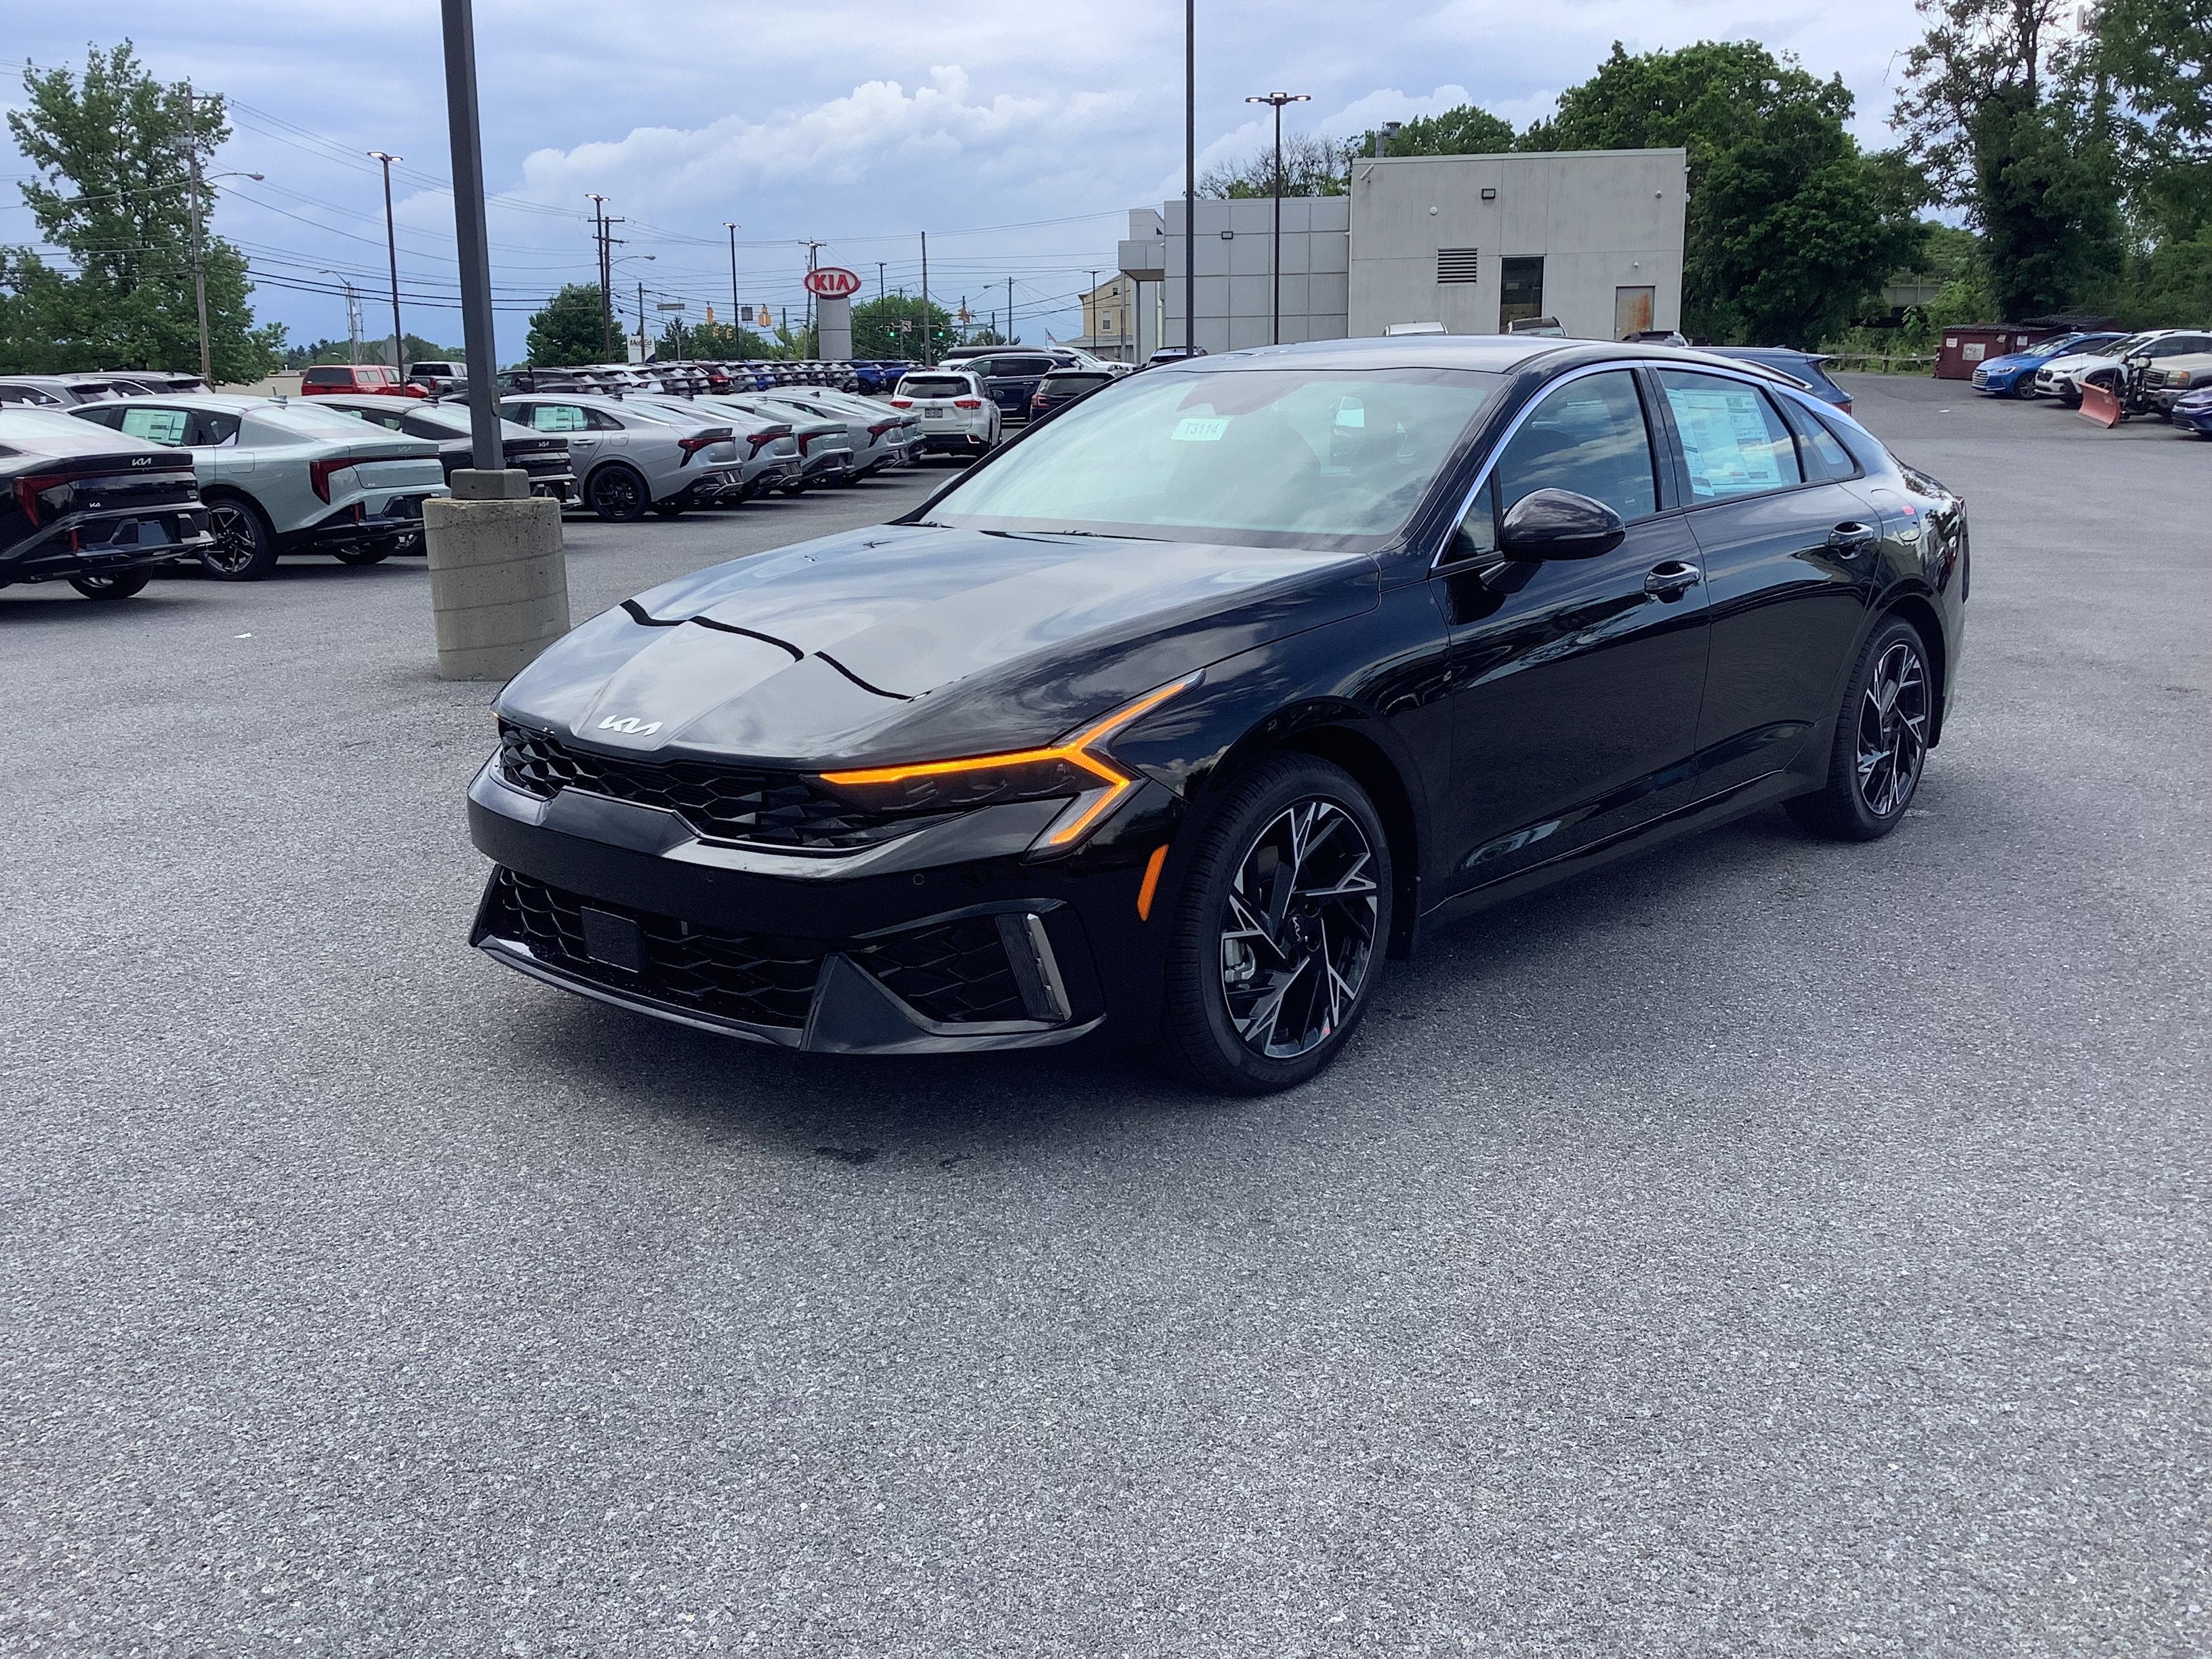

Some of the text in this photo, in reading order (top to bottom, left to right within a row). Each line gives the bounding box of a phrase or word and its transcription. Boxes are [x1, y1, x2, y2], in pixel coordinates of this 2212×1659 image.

[813, 274, 851, 291] KIA
[1185, 422, 1221, 434] T3114
[131, 457, 152, 466] KIA
[598, 714, 663, 737] KIA
